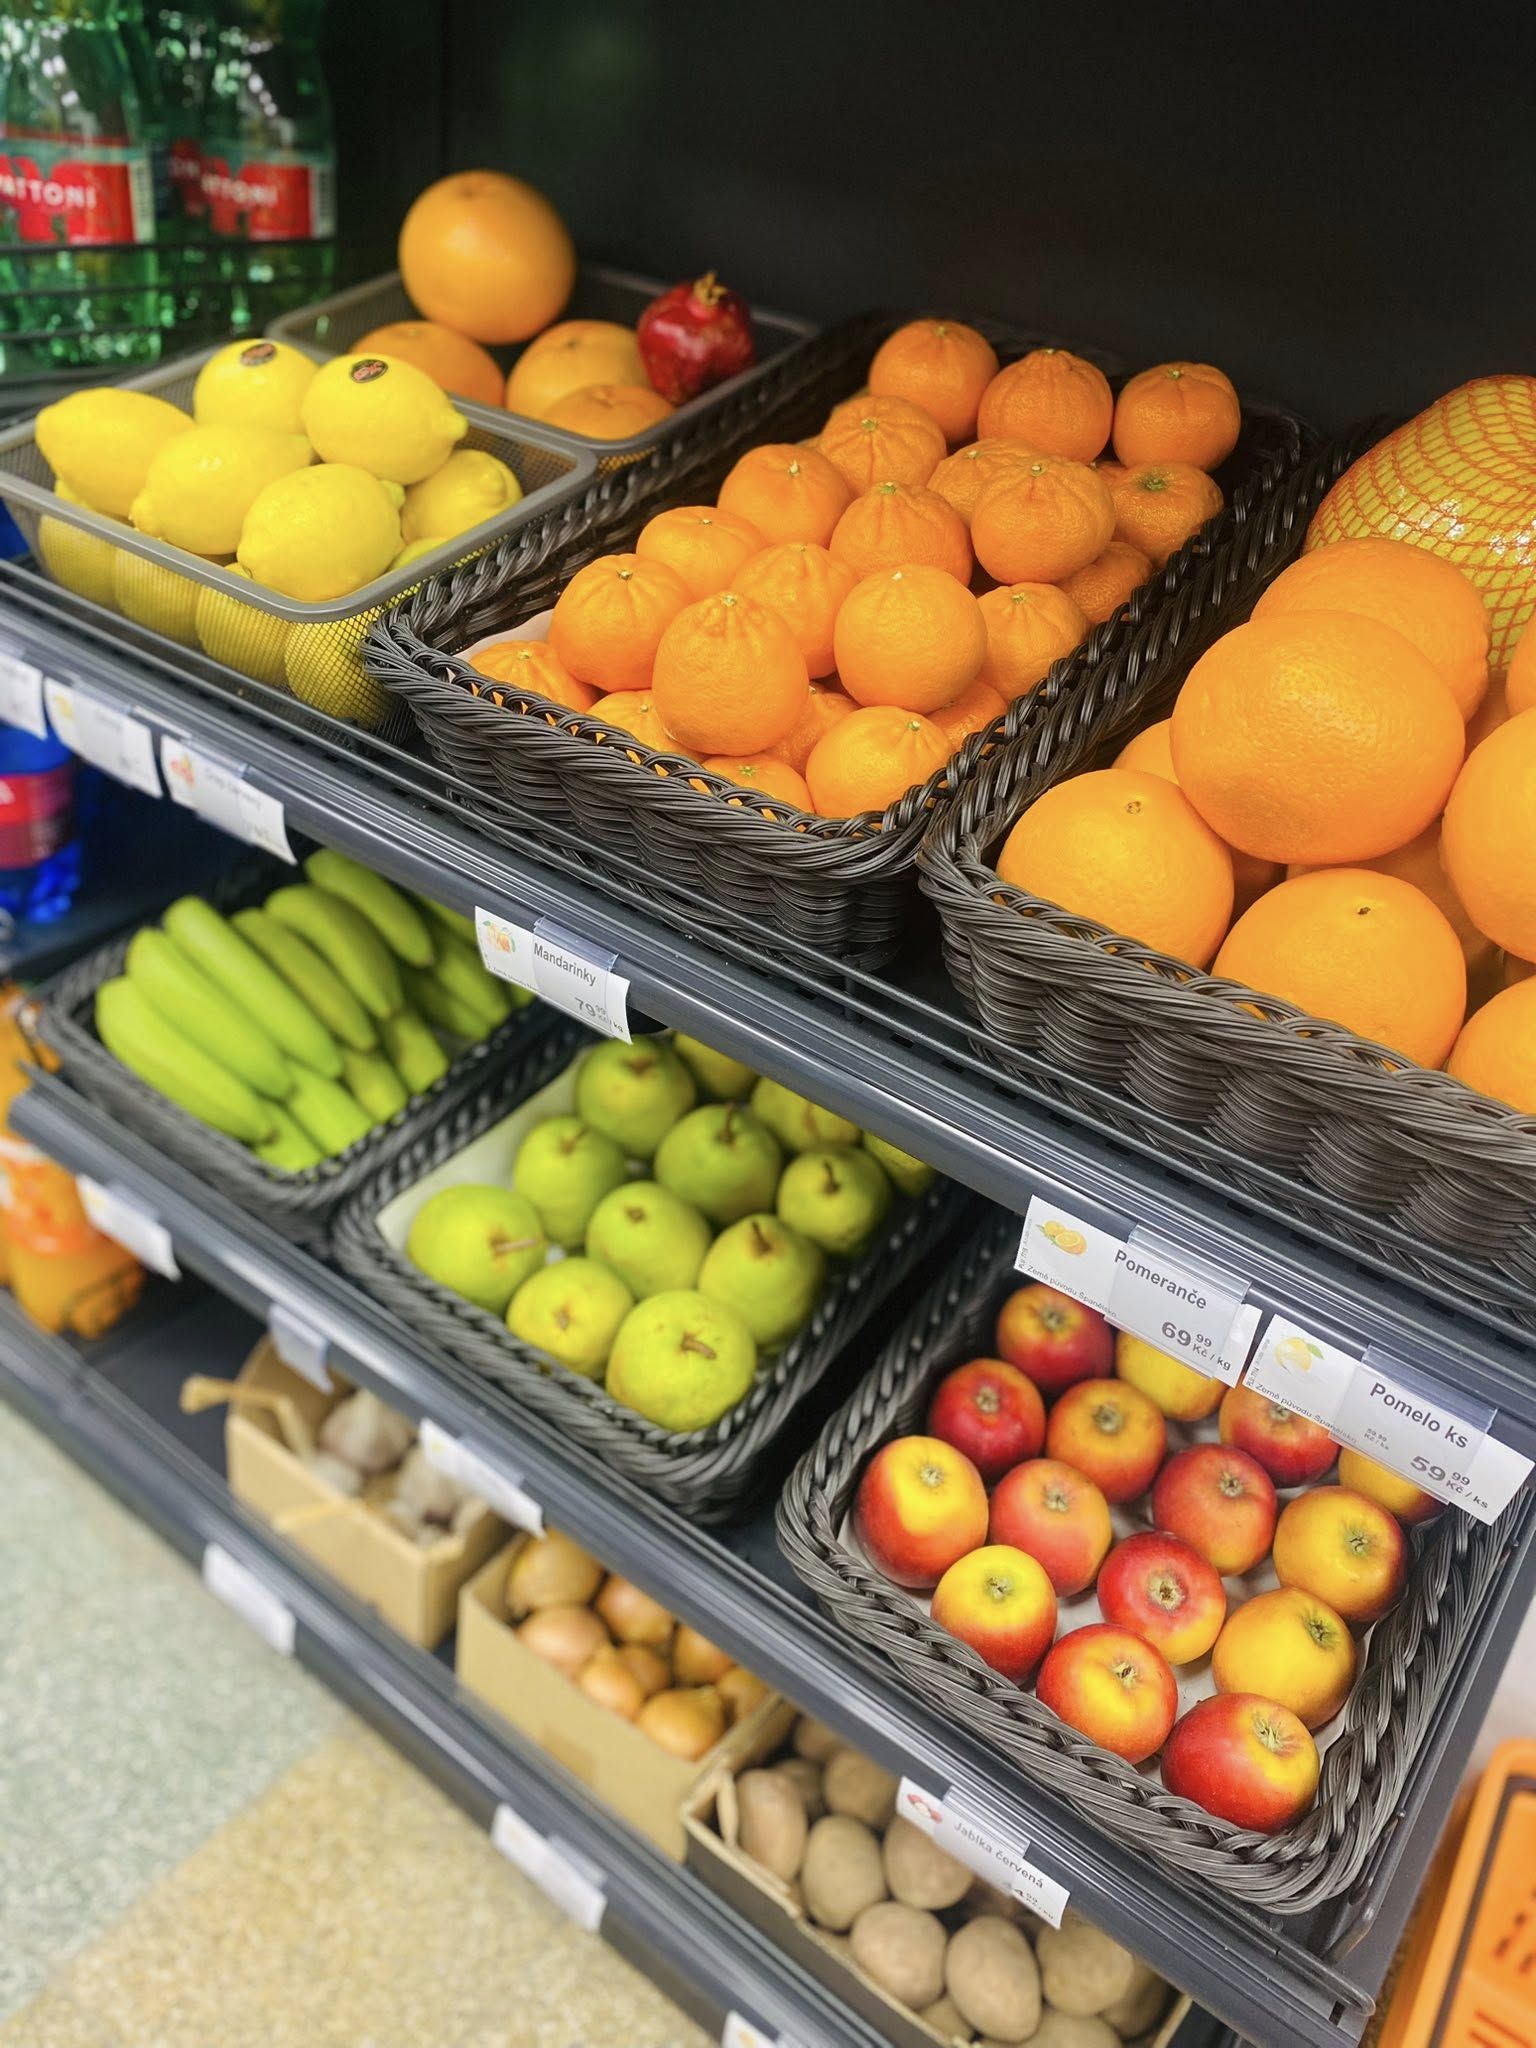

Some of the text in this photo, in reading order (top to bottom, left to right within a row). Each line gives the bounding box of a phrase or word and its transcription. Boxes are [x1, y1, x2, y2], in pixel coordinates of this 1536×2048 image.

[533, 943, 597, 987] Mandarinky
[575, 997, 596, 1017] 79
[1114, 1249, 1207, 1309] Pomeranče
[1161, 1321, 1191, 1347] 69
[1195, 1333, 1212, 1347] 99
[1193, 1344, 1207, 1357] Kč
[1217, 1356, 1231, 1371] kg
[1370, 1382, 1468, 1448] Pomelo ks
[1410, 1455, 1447, 1482] 59
[1451, 1472, 1471, 1486] 99
[1446, 1480, 1463, 1494] Kč
[1473, 1495, 1489, 1509] ks
[953, 1822, 1045, 1889] Jablka červená
